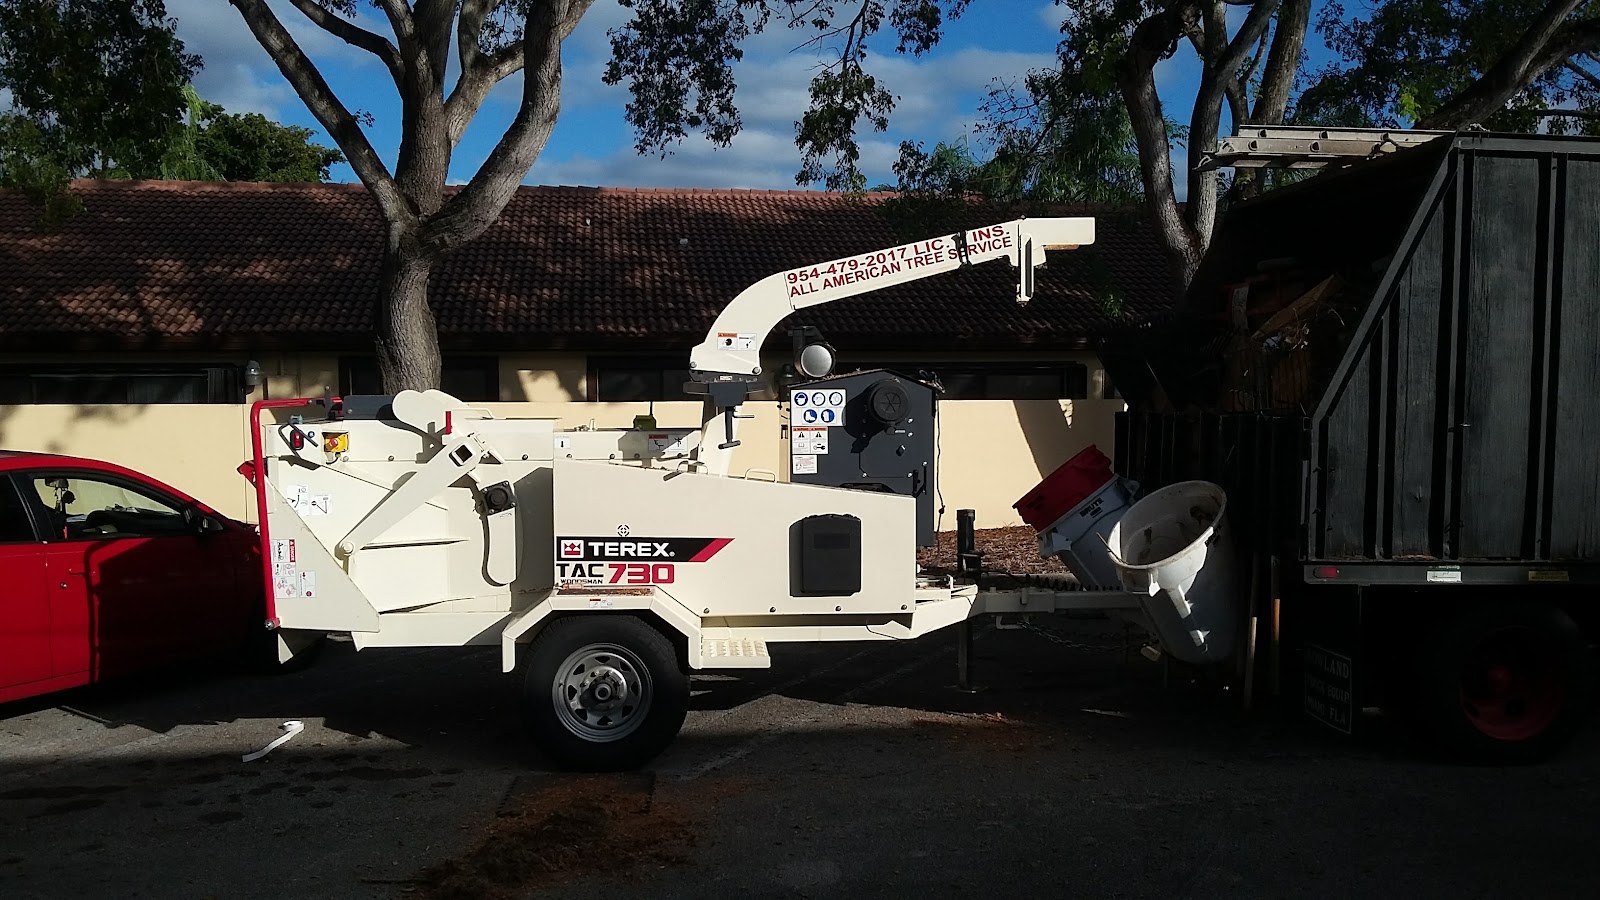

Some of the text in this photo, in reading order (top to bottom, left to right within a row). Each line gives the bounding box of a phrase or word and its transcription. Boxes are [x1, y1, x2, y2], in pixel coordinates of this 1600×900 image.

[787, 226, 1010, 284] 954-479-2017 LIC. INS.
[790, 282, 819, 297] ALL
[822, 262, 901, 290] AMERICAN
[906, 251, 944, 270] TREE
[1080, 498, 1104, 517] BRUTE
[556, 563, 675, 584] TAC 730
[1328, 685, 1350, 704] EQUIP
[1330, 705, 1346, 725] FLA
